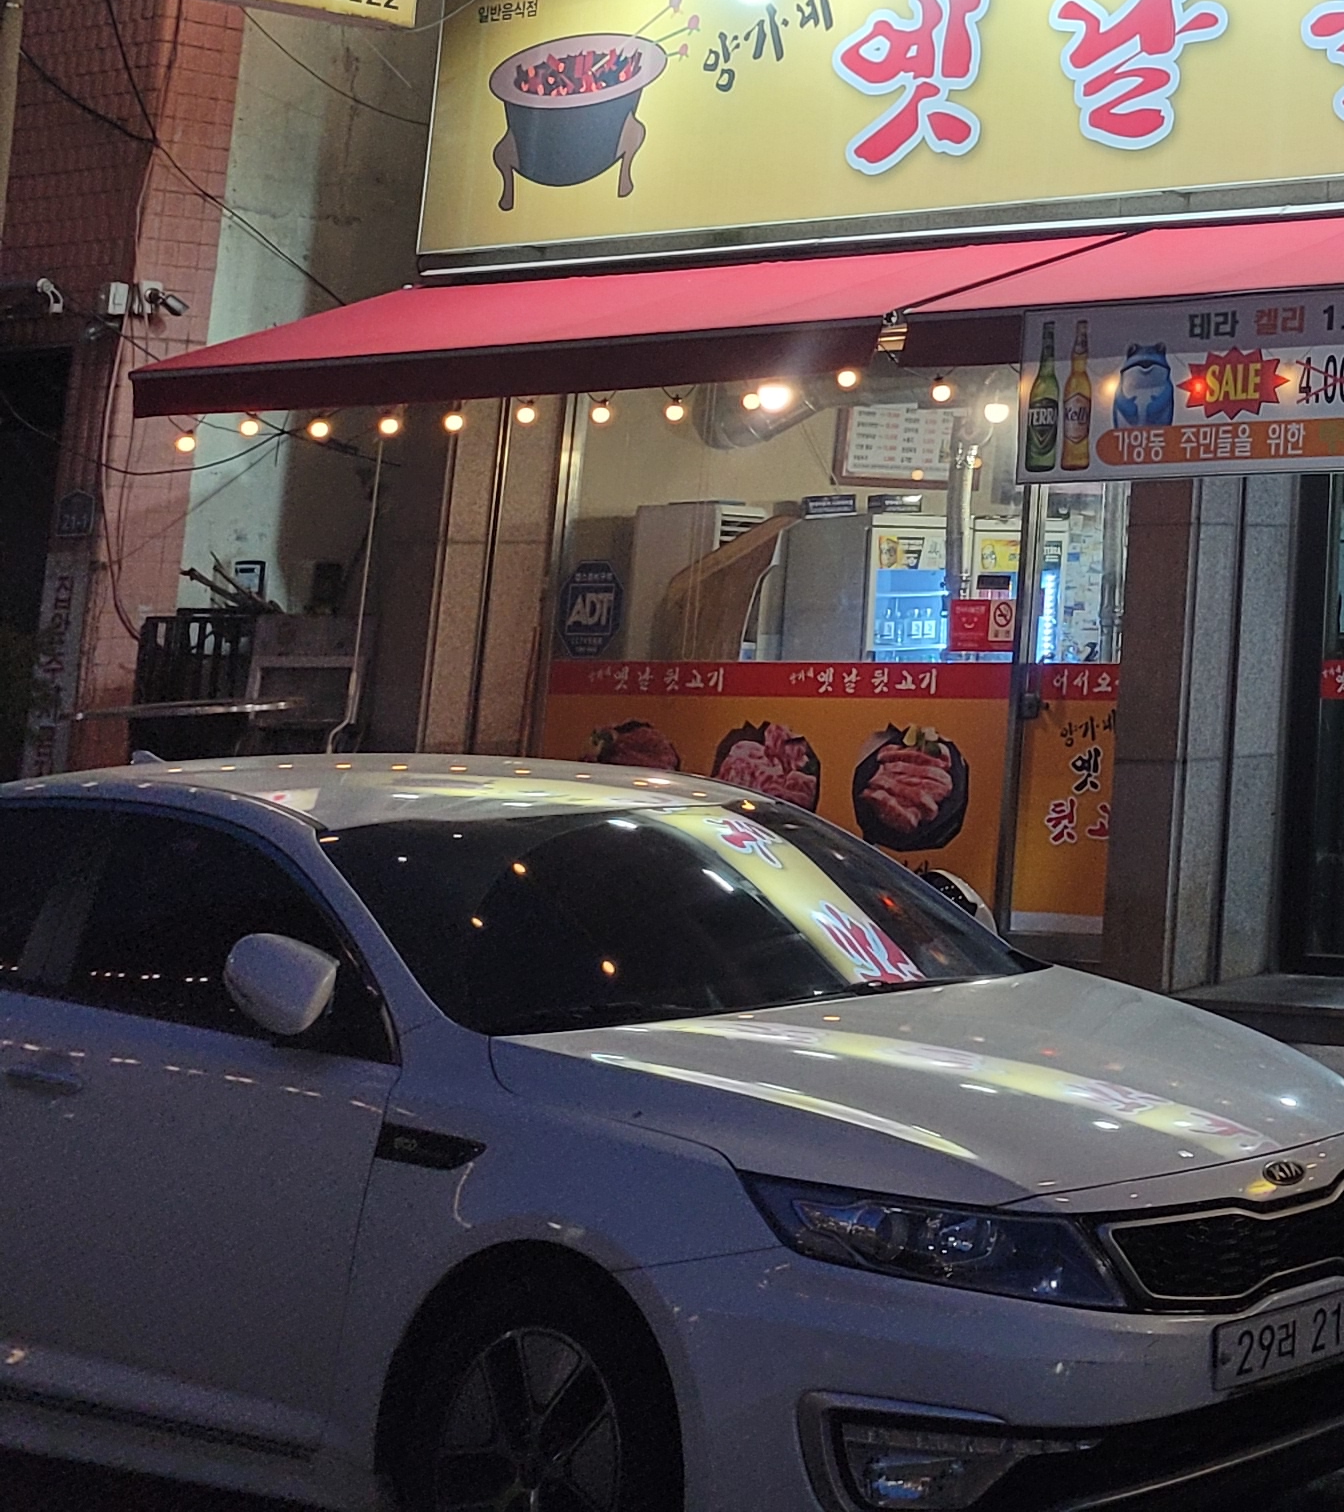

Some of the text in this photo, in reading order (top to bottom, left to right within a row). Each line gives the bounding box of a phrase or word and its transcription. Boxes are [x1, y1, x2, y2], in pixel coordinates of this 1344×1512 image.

[477, 0, 539, 25] 일반음식점
[1189, 310, 1239, 339] 테라
[1255, 306, 1305, 334] 켈리
[1205, 361, 1261, 404] SALE
[1112, 429, 1166, 463] 가양동
[1180, 426, 1252, 461] 주민들을
[1266, 422, 1306, 457] 위한
[566, 592, 615, 626] ADT
[1053, 668, 1120, 696] 어서오
[1269, 1162, 1302, 1181] KIA
[1236, 1319, 1297, 1377] 29러
